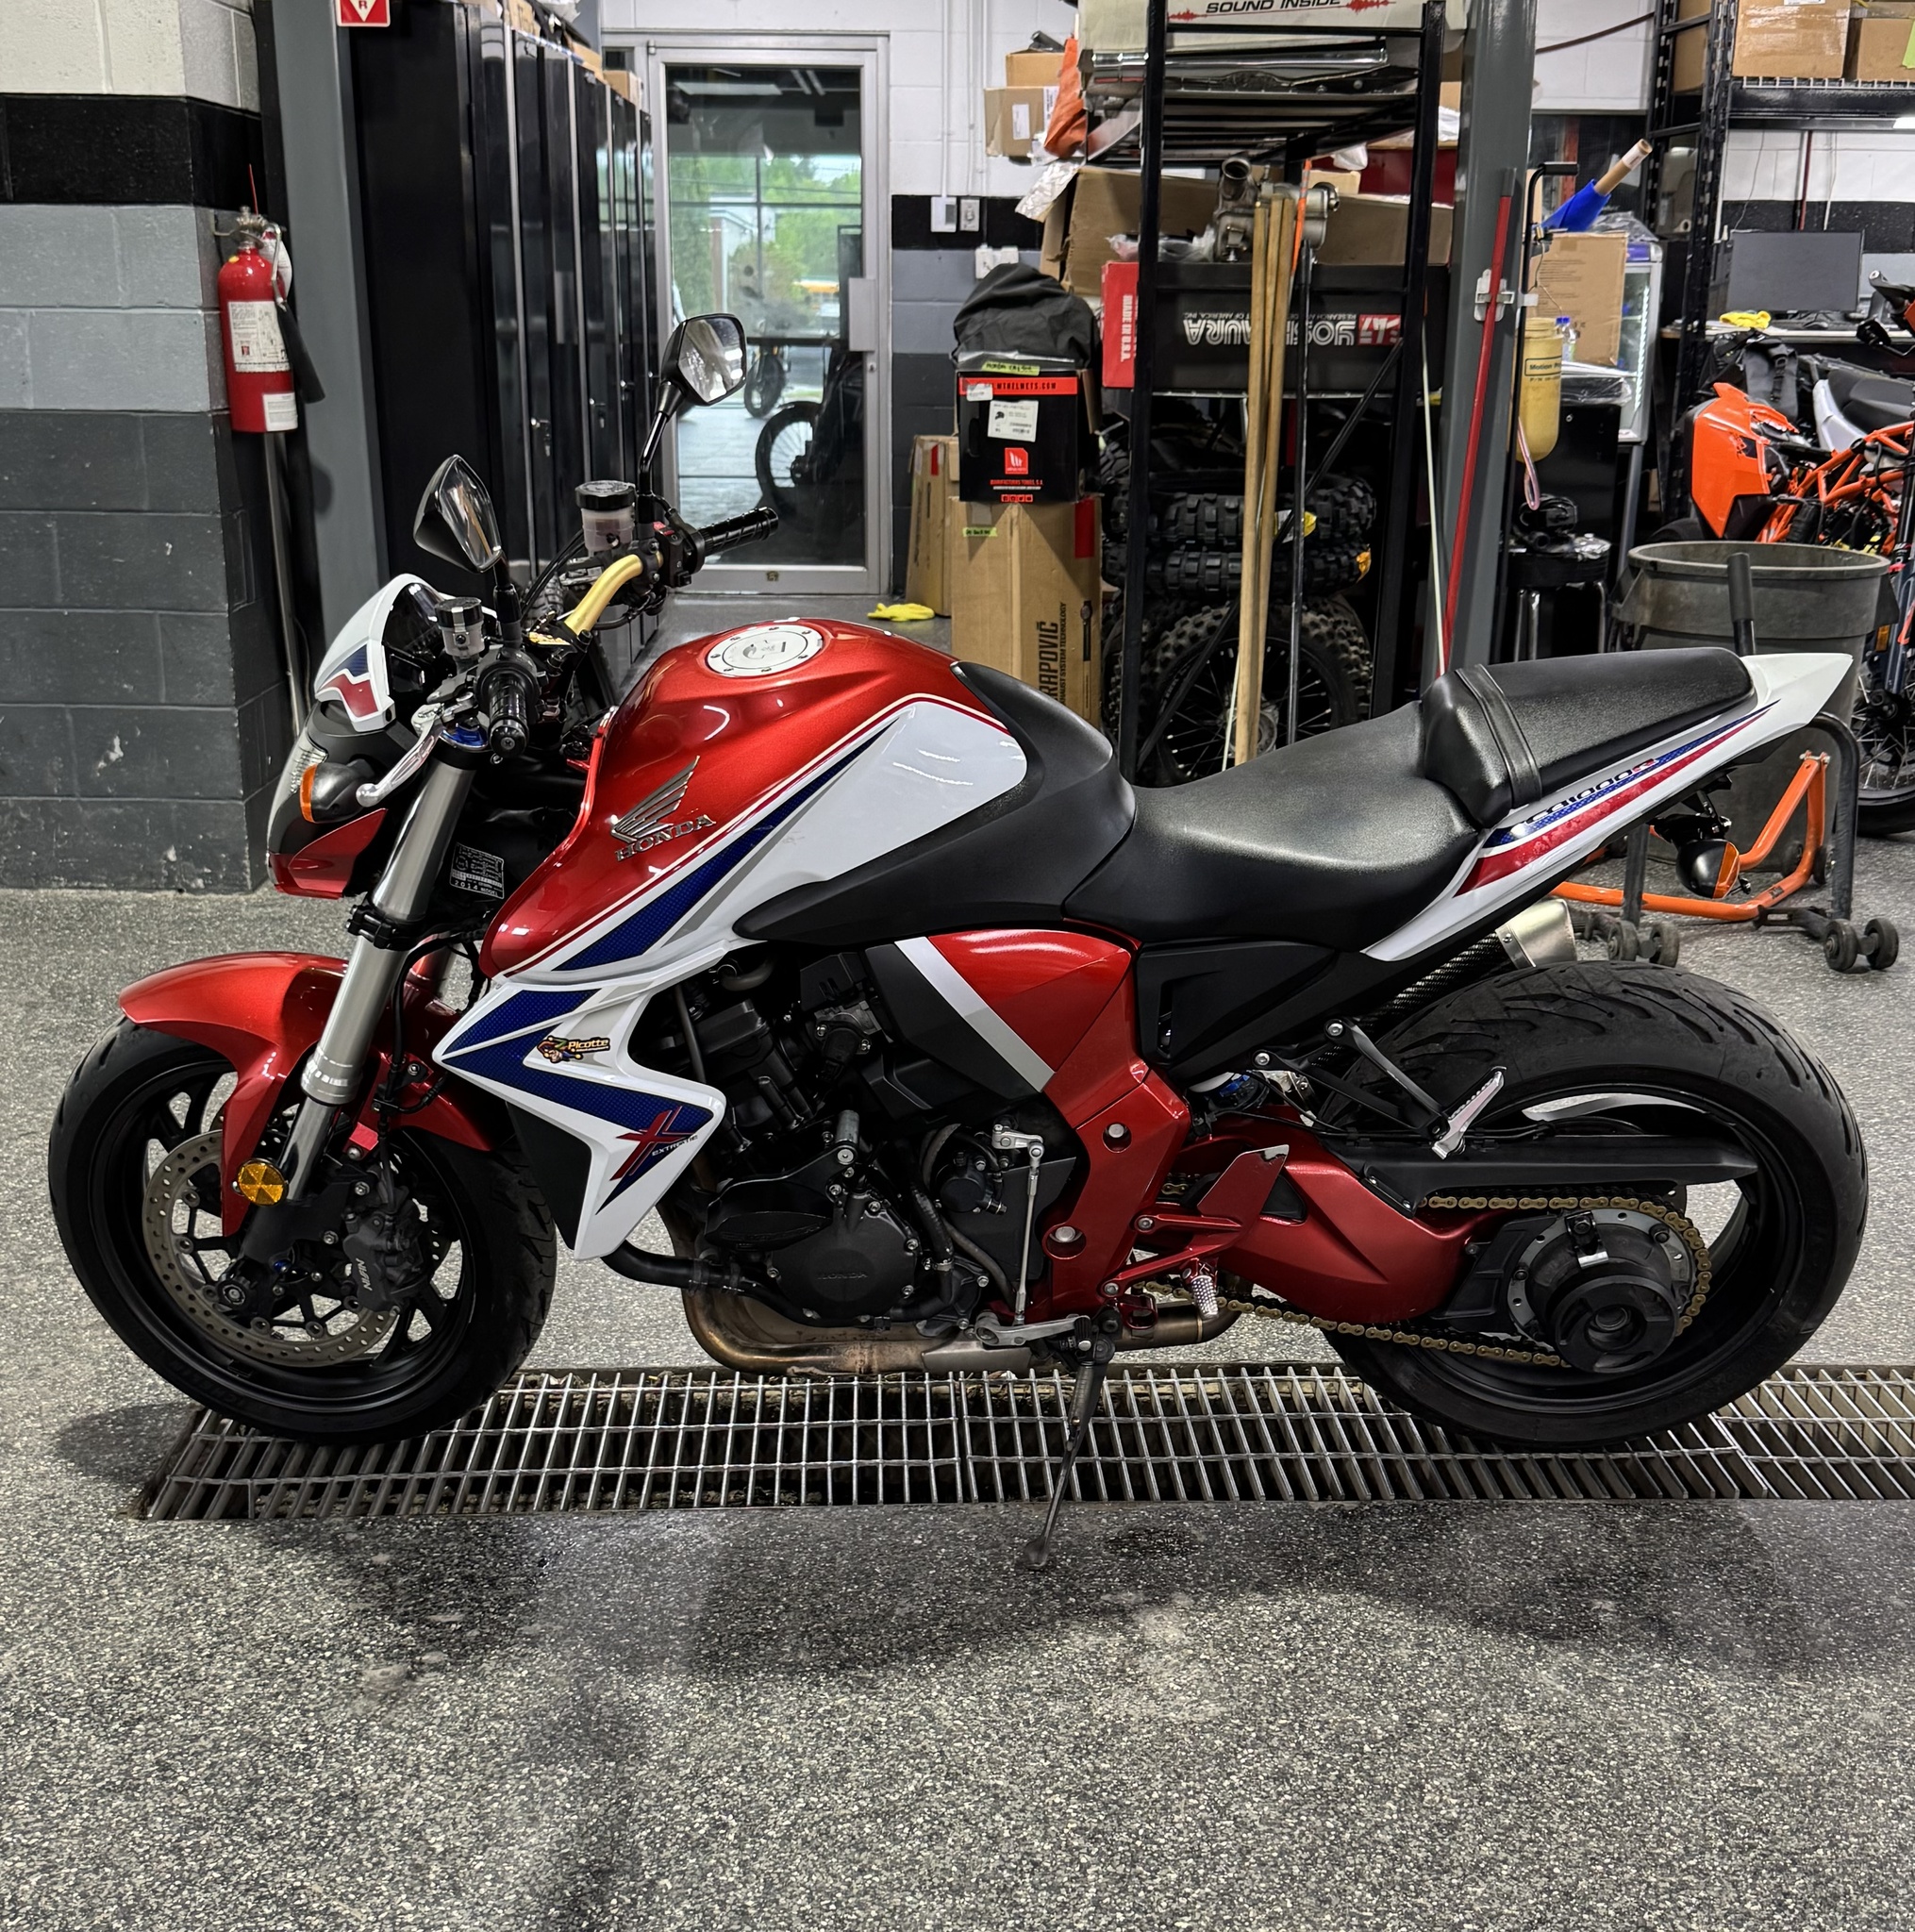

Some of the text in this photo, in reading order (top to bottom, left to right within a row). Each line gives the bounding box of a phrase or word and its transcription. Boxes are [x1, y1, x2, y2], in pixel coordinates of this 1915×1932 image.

[358, 0, 368, 9] R
[1206, 0, 1274, 13] SOUND
[1183, 319, 1357, 346] YOHURA
[1036, 621, 1058, 702] RAPOVIČ
[615, 814, 717, 862] HONDA
